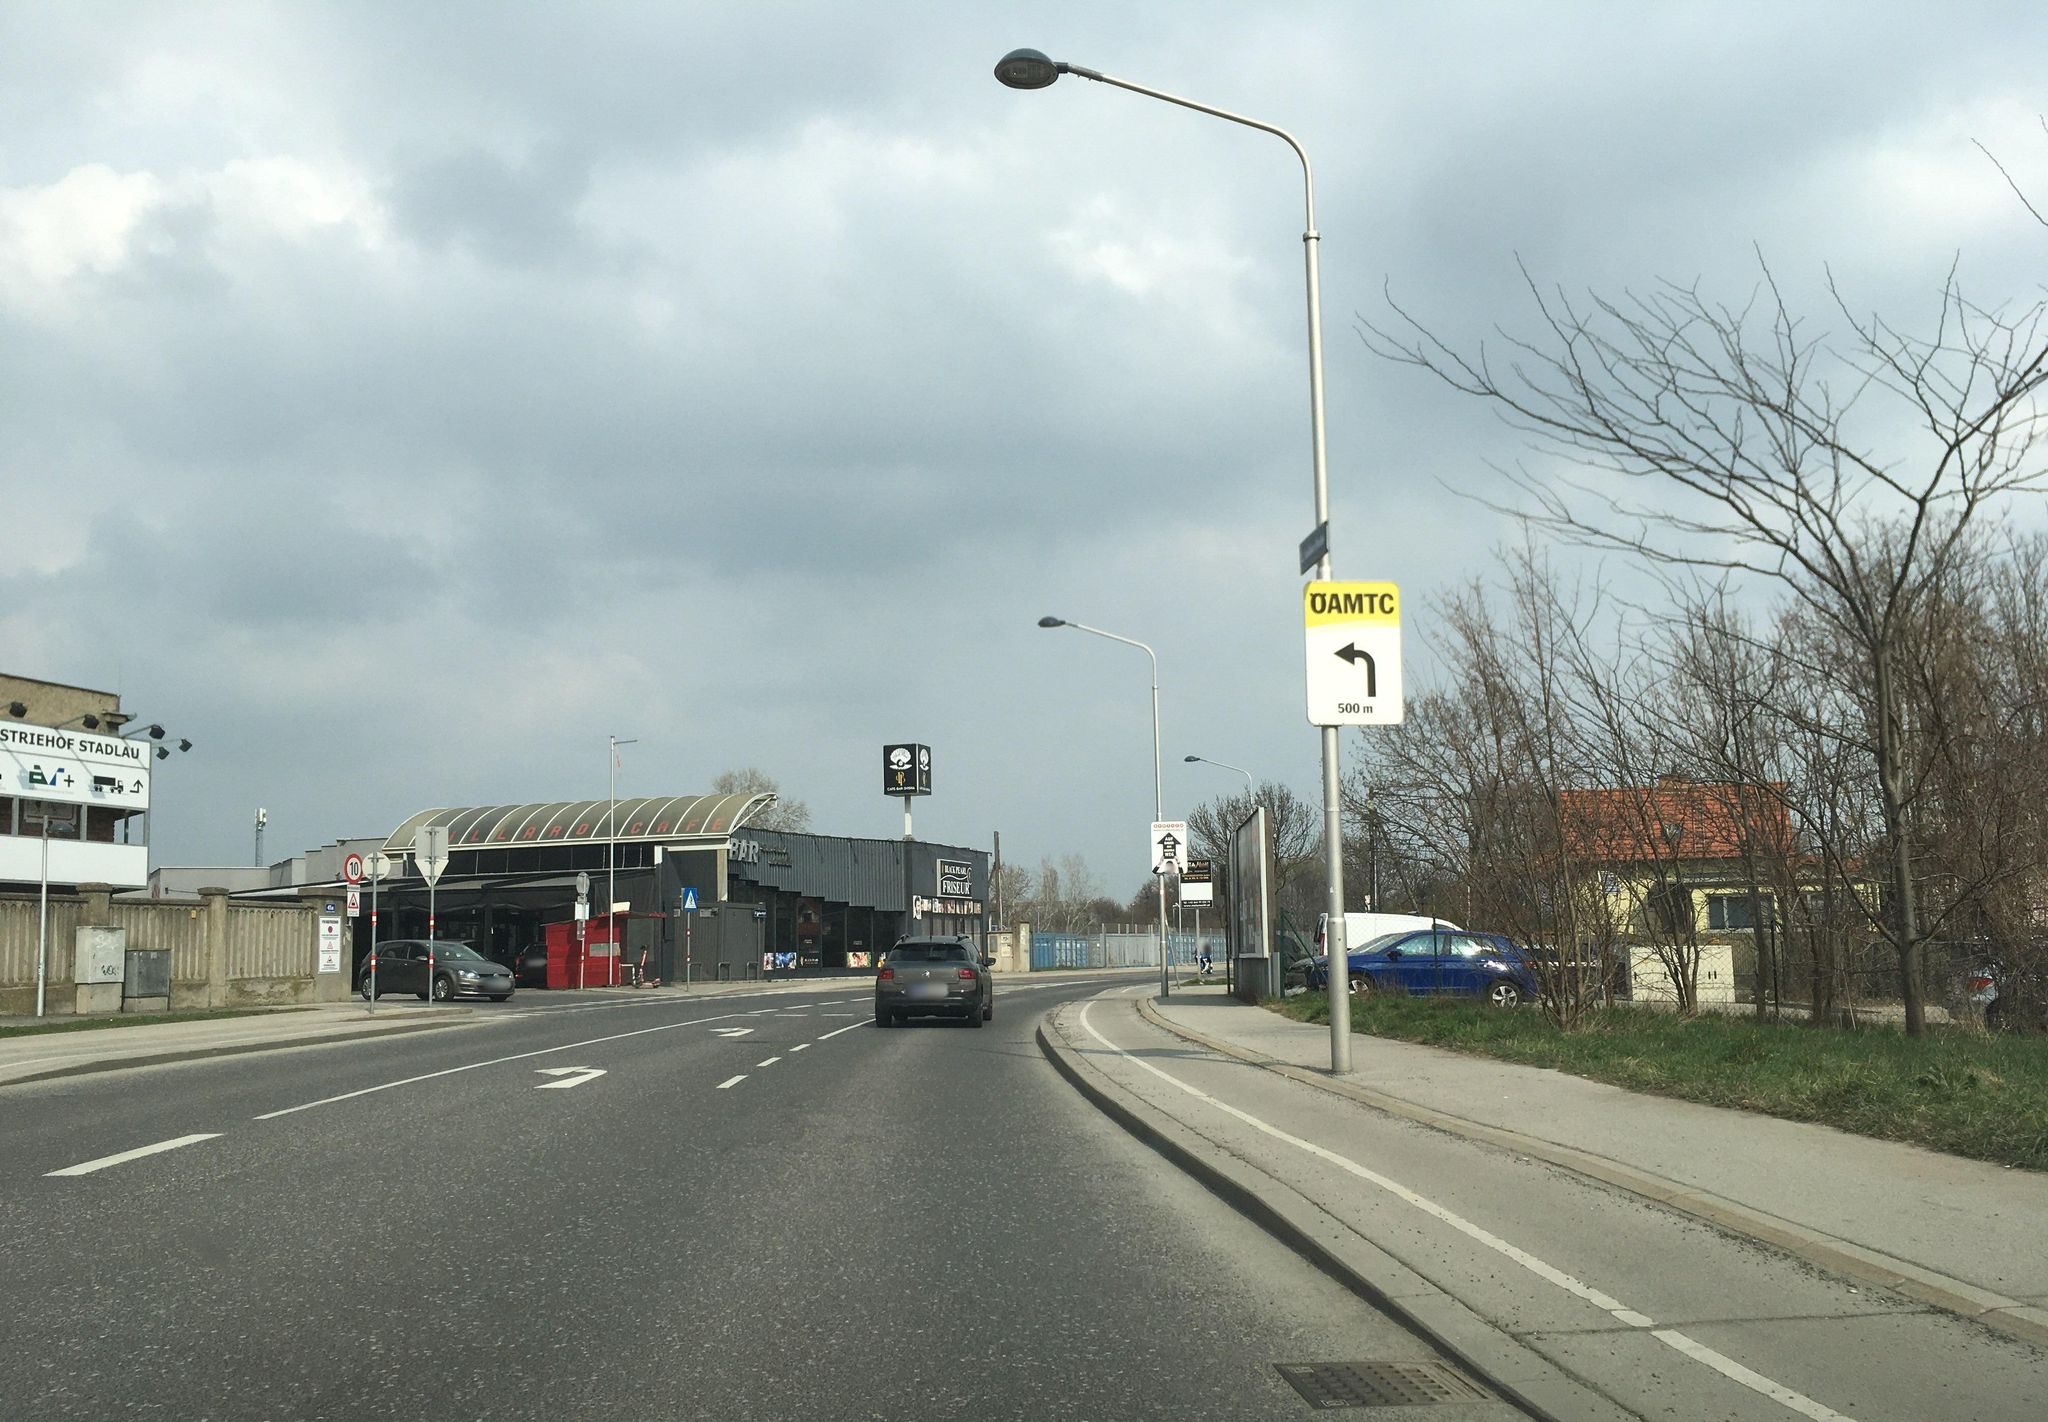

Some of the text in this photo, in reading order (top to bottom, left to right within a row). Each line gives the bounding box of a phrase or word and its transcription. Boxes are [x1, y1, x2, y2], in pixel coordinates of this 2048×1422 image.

[1310, 592, 1394, 615] ÖAMTC
[1338, 702, 1373, 714] 500 m
[79, 740, 140, 760] STADLAU
[449, 823, 589, 842] ILLARD
[730, 838, 759, 863] BAR
[350, 861, 359, 876] 10
[943, 880, 970, 895] FRISEUR
